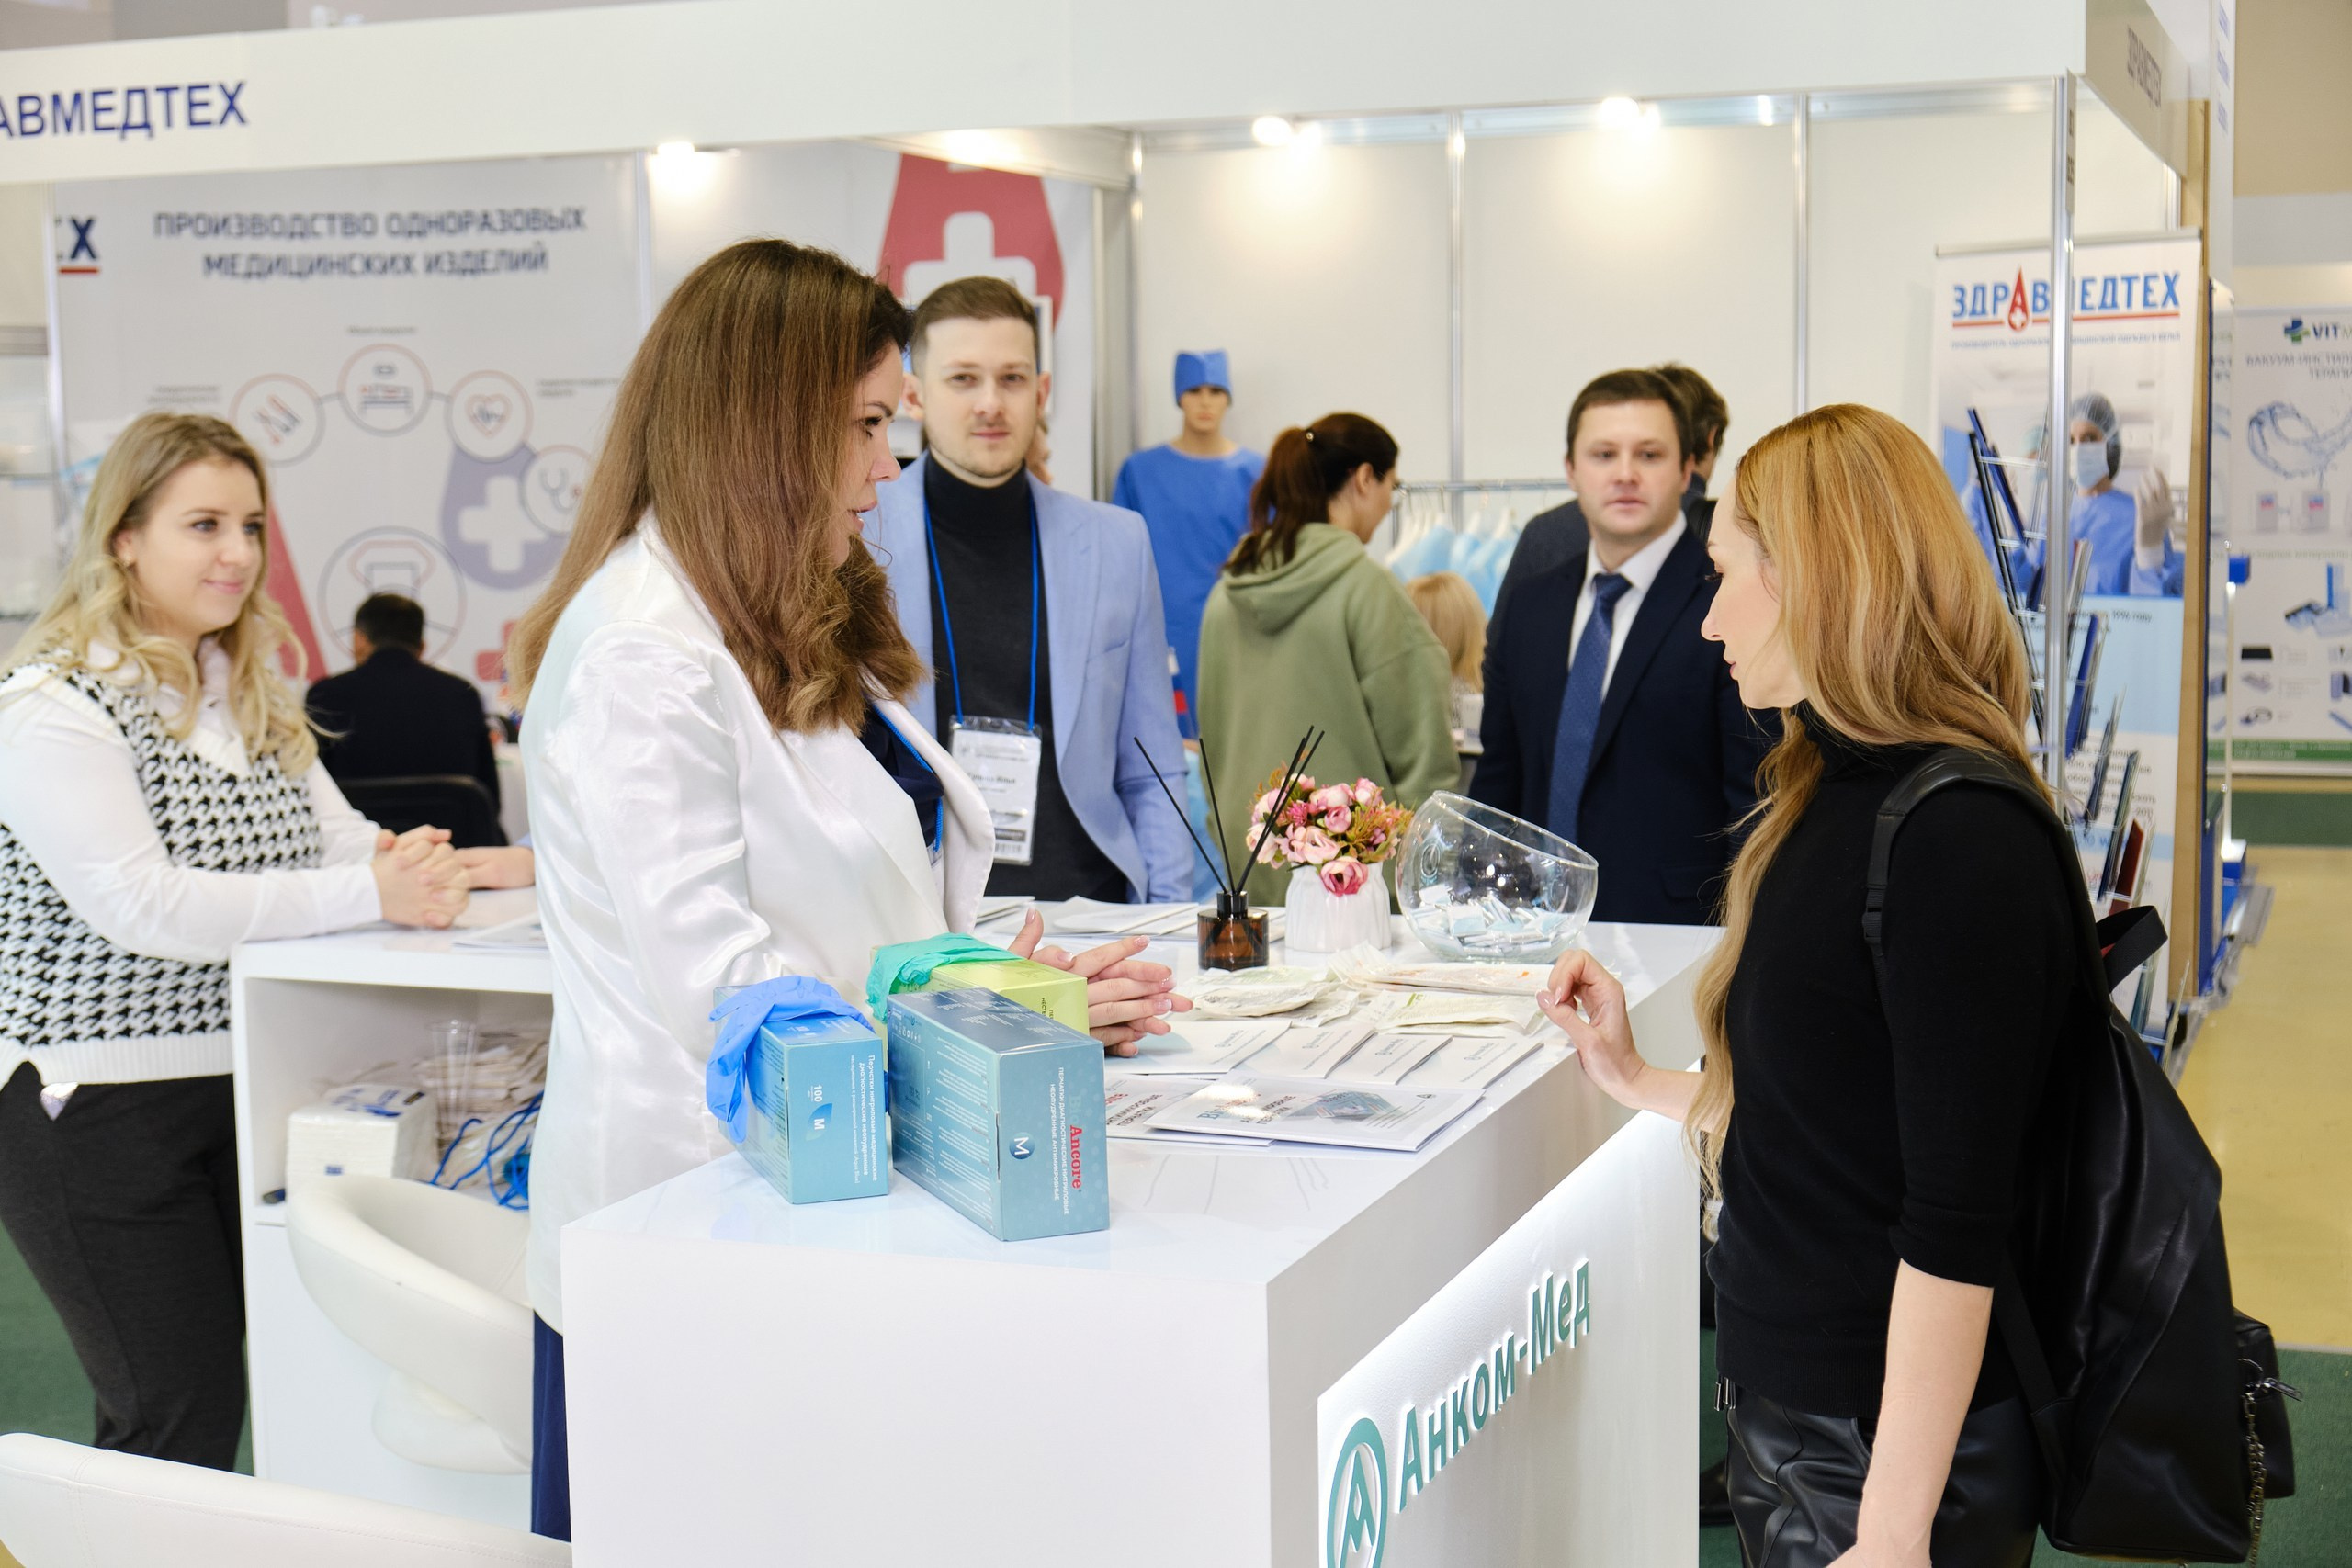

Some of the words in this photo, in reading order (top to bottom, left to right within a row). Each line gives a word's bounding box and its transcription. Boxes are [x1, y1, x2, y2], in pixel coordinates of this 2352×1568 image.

[154, 211, 378, 241] ПРОИЗВОДСТВО
[387, 206, 587, 239] ОДНОРАЗОВЫХ
[204, 251, 415, 280] МЕДИЦИНСКИХ
[424, 241, 548, 276] ИЗДЕЛИЙ
[1952, 265, 2180, 326] ЗДРАВЕДТЕХ
[859, 1063, 867, 1122] диагностические
[867, 1055, 876, 1089] Перчатки
[813, 1084, 823, 1102] 100
[868, 1090, 876, 1133] нитриловые
[814, 1118, 825, 1130] M
[1058, 1102, 1068, 1168] ДИАГНОСТИЧЕСКИЕ
[1013, 1137, 1029, 1155] M
[1052, 1140, 1060, 1201] АНТИМИКРОБНЫЕ
[1396, 1259, 1590, 1514] Анком-Мед
